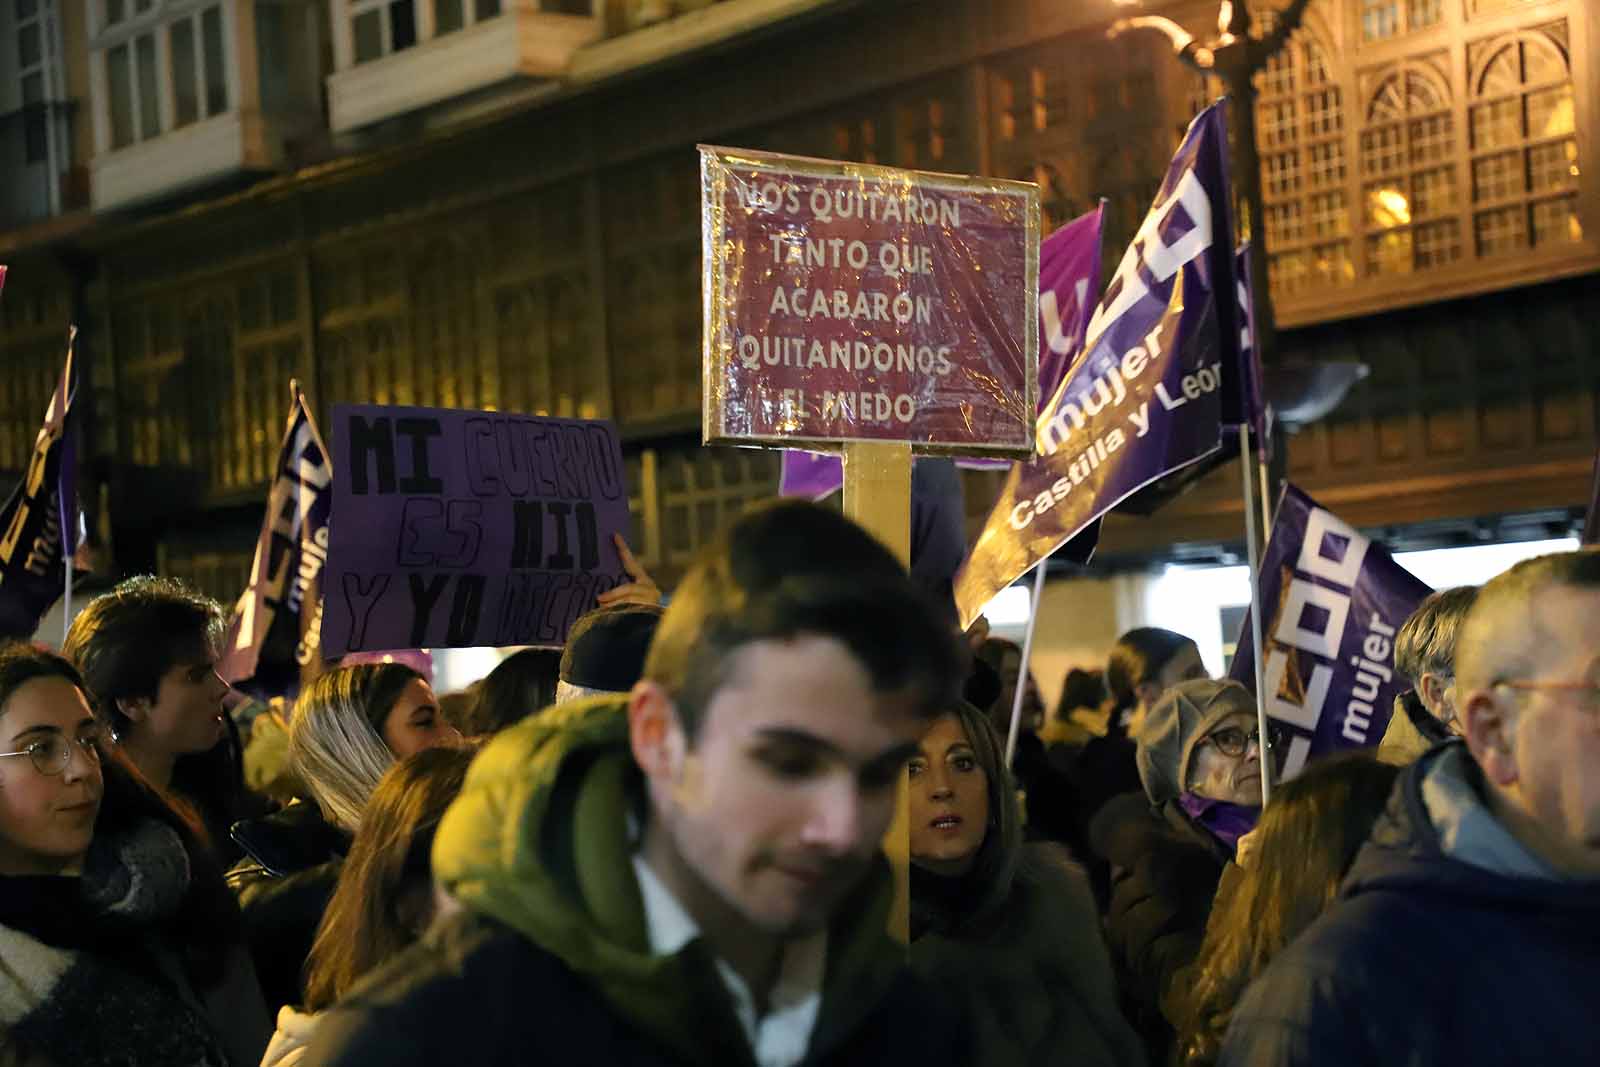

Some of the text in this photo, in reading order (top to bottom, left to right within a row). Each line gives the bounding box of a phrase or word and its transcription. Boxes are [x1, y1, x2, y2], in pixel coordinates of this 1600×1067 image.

[736, 181, 962, 229] NOS QUITARON
[768, 234, 934, 279] TANTO QUE
[769, 286, 932, 325] ACABARON
[738, 335, 952, 376] QUITANDONOS
[1040, 321, 1167, 458] mujer
[783, 388, 917, 424] EL MIEDO
[348, 415, 622, 500] MI CUERPO
[1008, 428, 1125, 532] Castilla
[1130, 403, 1152, 438] y
[287, 514, 331, 615] muje
[397, 497, 483, 569] ES
[343, 572, 393, 652] Y
[407, 572, 487, 647] YO
[1341, 612, 1399, 745] mujer
